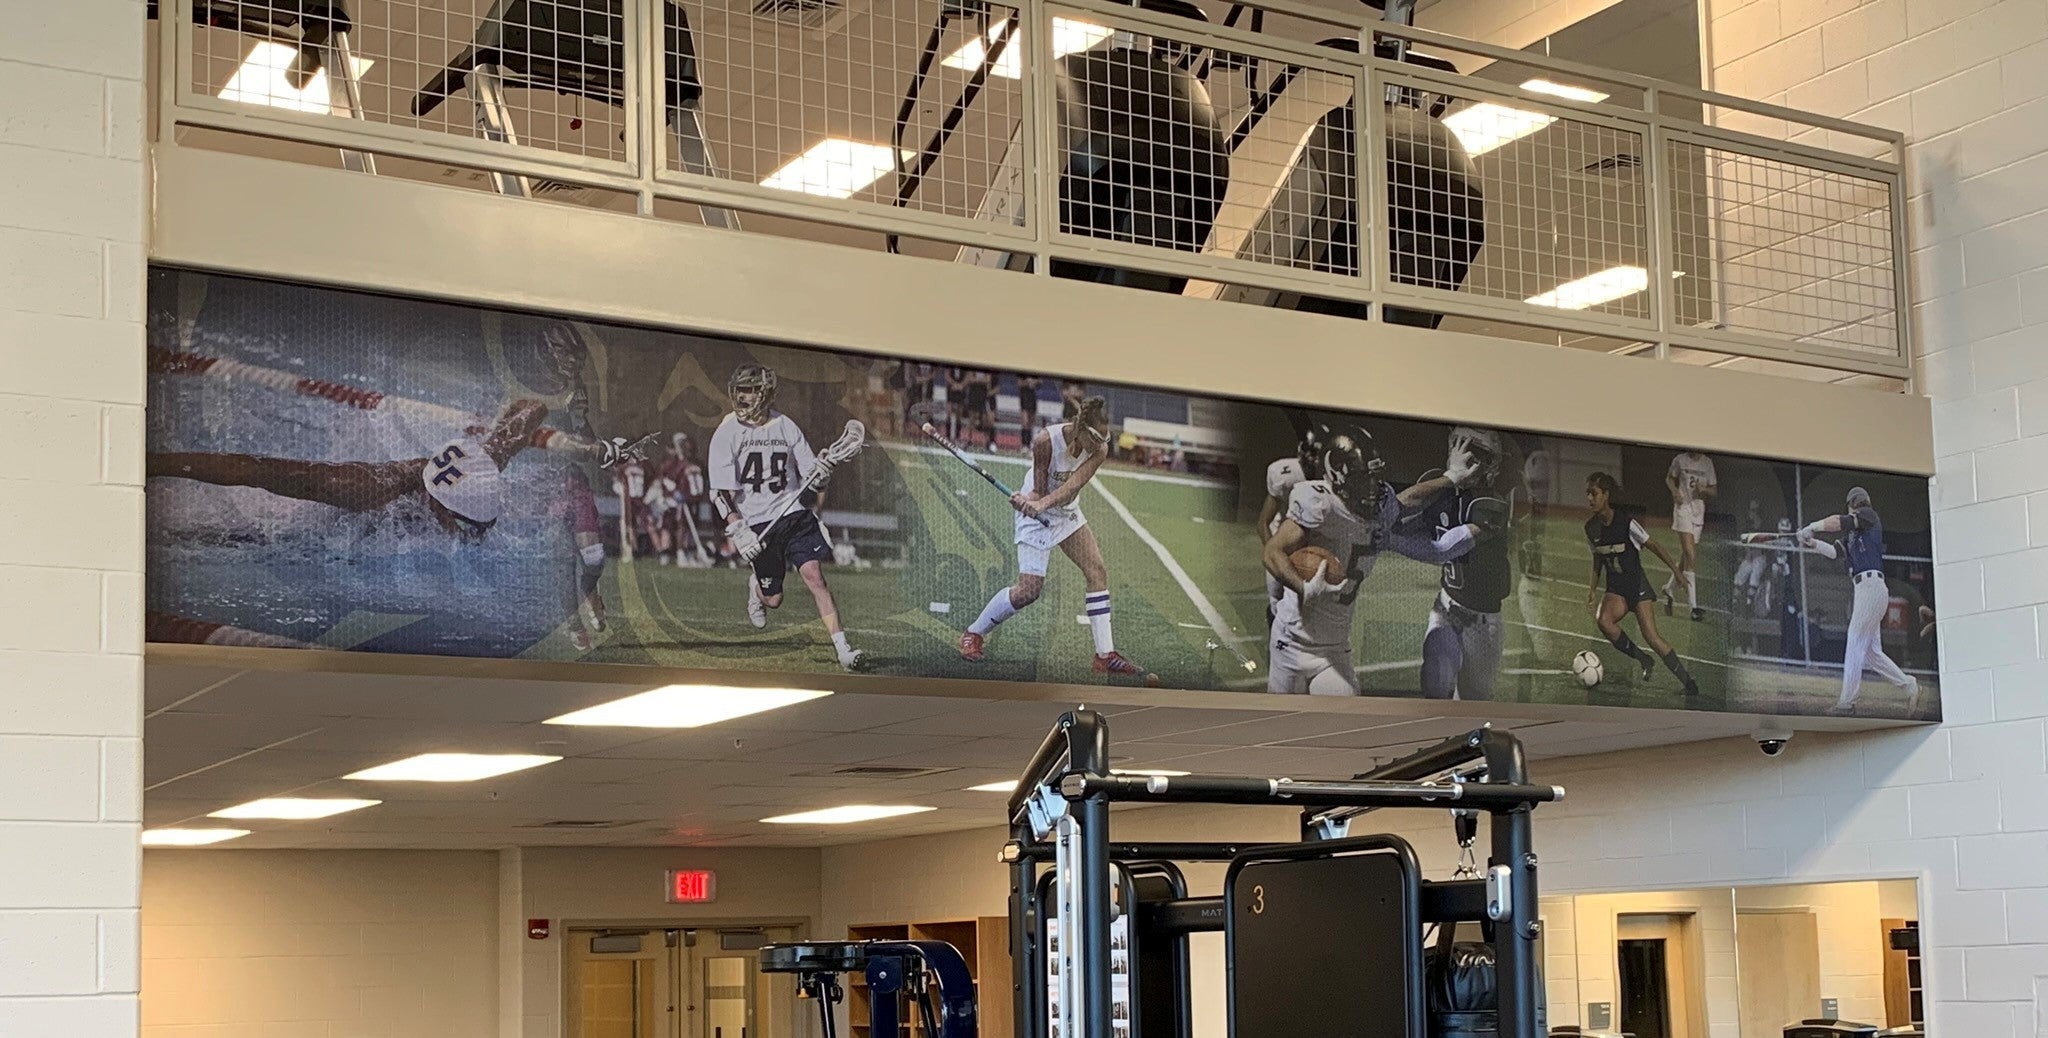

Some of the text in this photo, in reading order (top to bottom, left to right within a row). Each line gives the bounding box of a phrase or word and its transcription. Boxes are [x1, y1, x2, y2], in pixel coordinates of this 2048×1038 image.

[432, 445, 466, 486] SF
[740, 451, 788, 494] 49
[1311, 484, 1331, 495] 5
[676, 872, 708, 899] EXIT
[1252, 885, 1264, 914] 3
